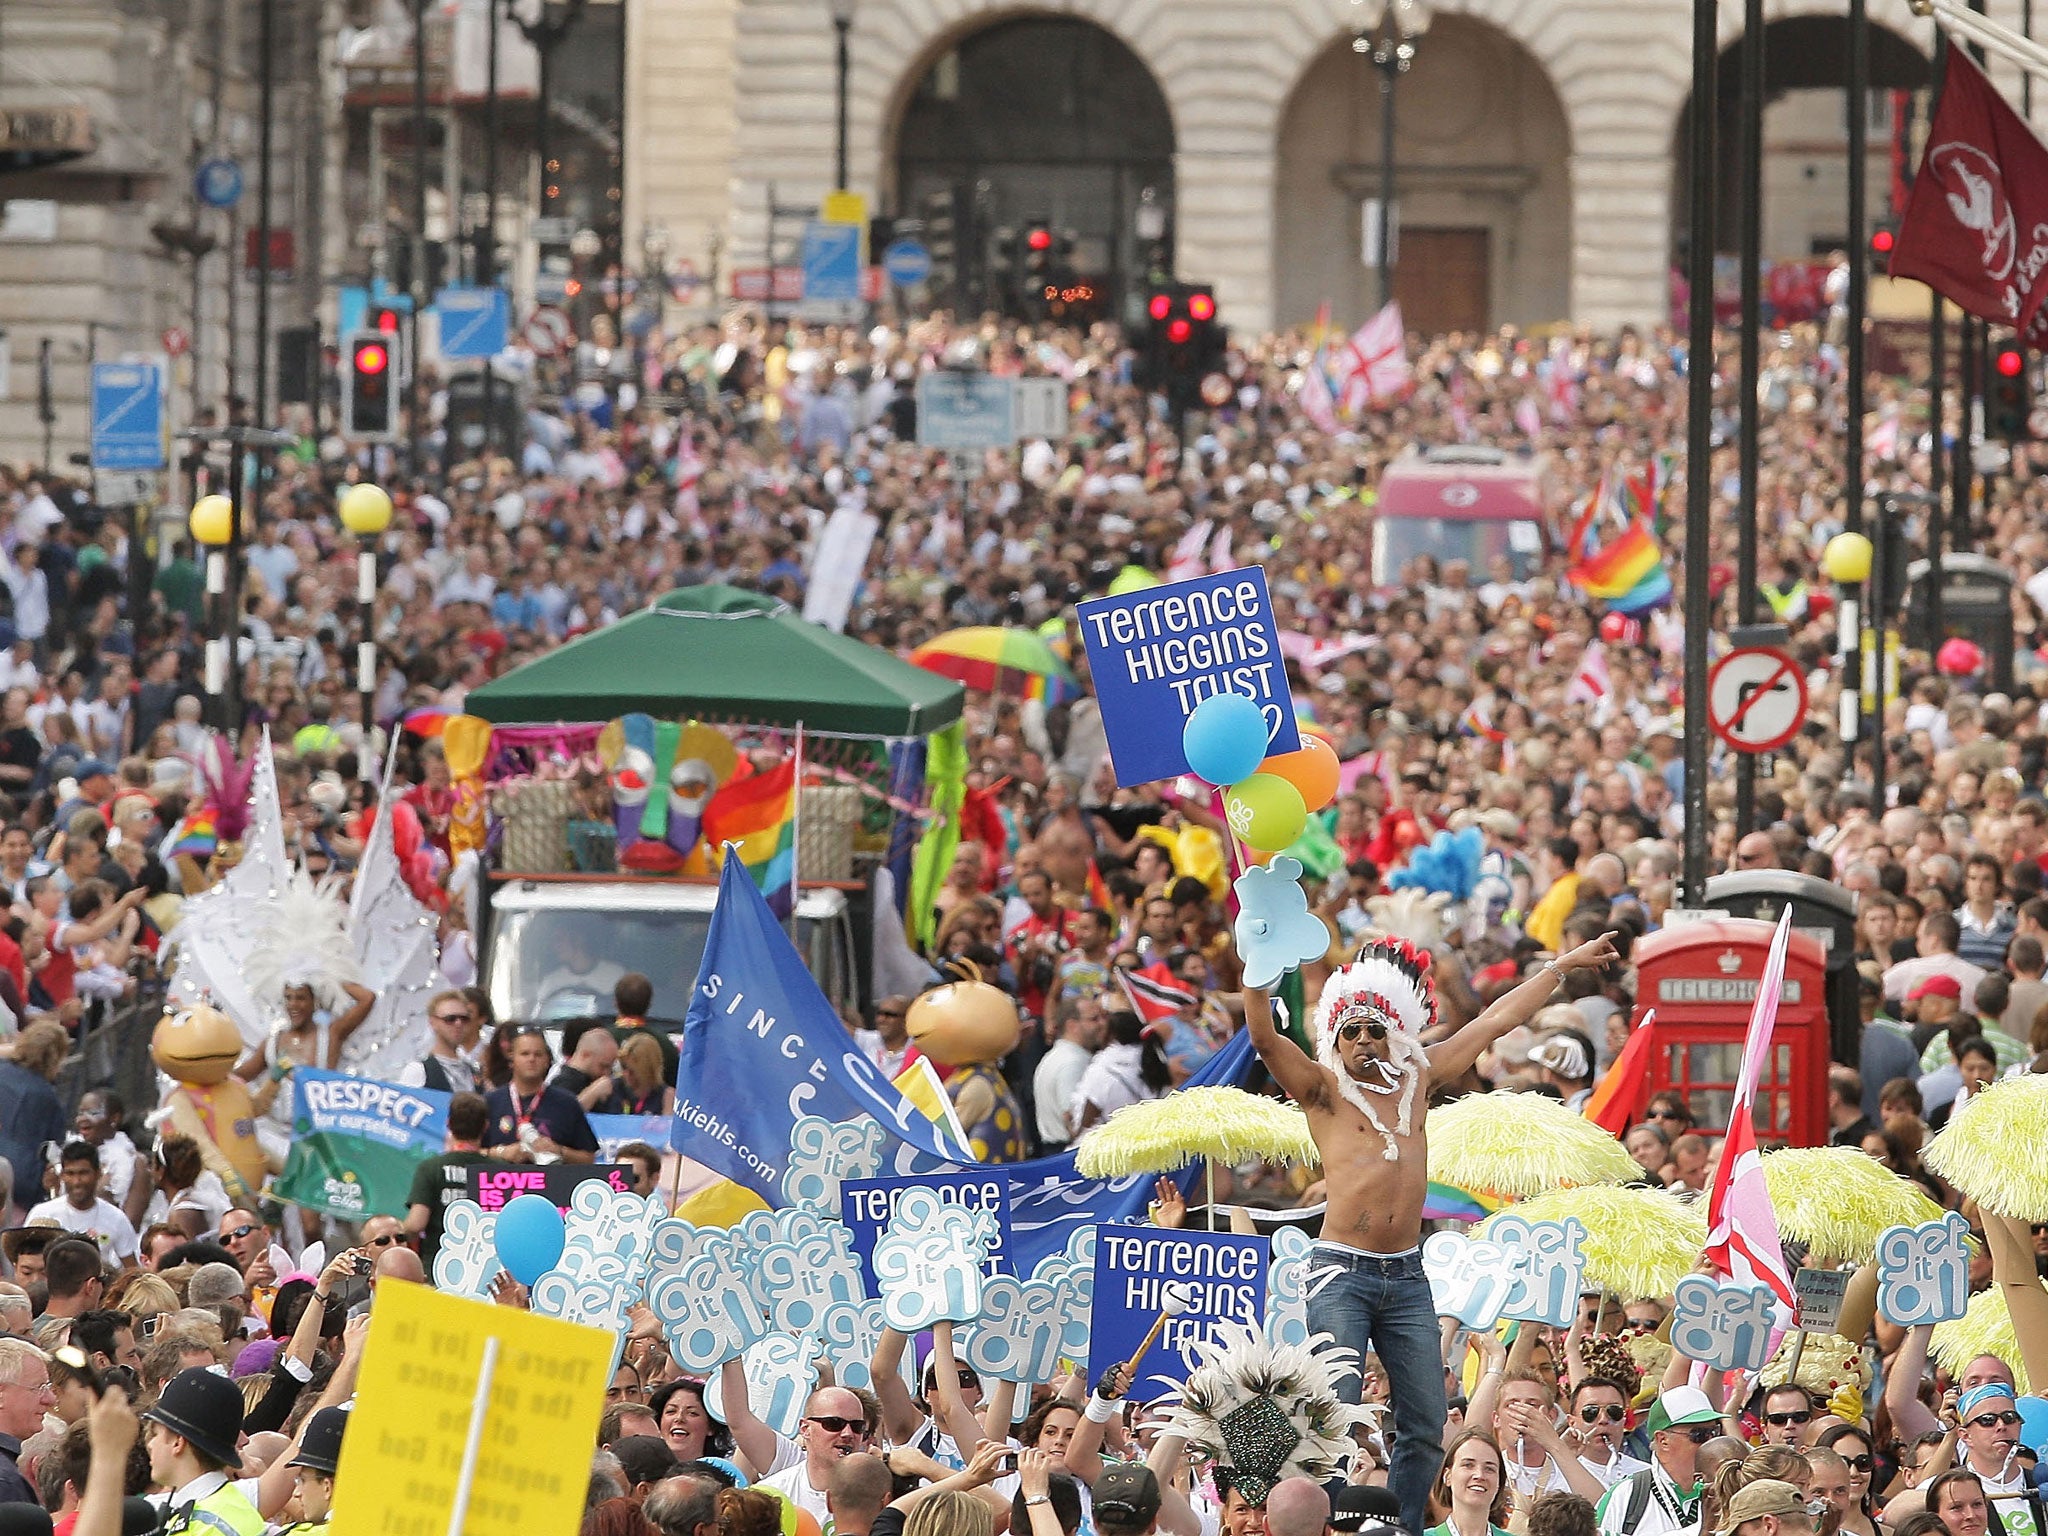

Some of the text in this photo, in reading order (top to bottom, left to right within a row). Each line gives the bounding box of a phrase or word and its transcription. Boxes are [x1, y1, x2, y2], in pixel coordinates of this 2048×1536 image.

[1087, 581, 1260, 648] Terrence
[304, 1080, 435, 1128] RESPECT
[339, 1114, 411, 1145] ourselves
[796, 1117, 885, 1157] get
[478, 1172, 546, 1190] LOVE
[824, 1152, 845, 1177] it
[479, 1190, 505, 1206] IS
[576, 1185, 665, 1231] get
[848, 1182, 1001, 1222] Ternce
[448, 1203, 498, 1246] ge
[597, 1214, 618, 1241] it
[1884, 1217, 1970, 1268] get
[466, 1237, 484, 1265] it
[763, 1227, 851, 1284] get
[878, 1228, 975, 1280] get
[1103, 1236, 1258, 1280] Terrence
[1426, 1234, 1525, 1279] get
[1452, 1259, 1476, 1282] it
[1524, 1250, 1545, 1278] it
[1914, 1255, 1932, 1282] it
[660, 1243, 737, 1320] get
[801, 1271, 825, 1296] it
[884, 1262, 979, 1327] on
[914, 1263, 936, 1286] it
[1886, 1255, 1966, 1322] on
[537, 1276, 631, 1318] get
[694, 1296, 720, 1323] it
[983, 1282, 1076, 1324] get
[1125, 1276, 1255, 1318] HIGINS
[1675, 1282, 1778, 1324] get
[672, 1266, 765, 1370] on
[828, 1306, 883, 1344] ge
[1010, 1310, 1031, 1338] it
[1711, 1310, 1730, 1336] it
[762, 1334, 821, 1366] et
[972, 1315, 1070, 1380] on
[1671, 1312, 1774, 1371] on
[750, 1358, 772, 1386] it
